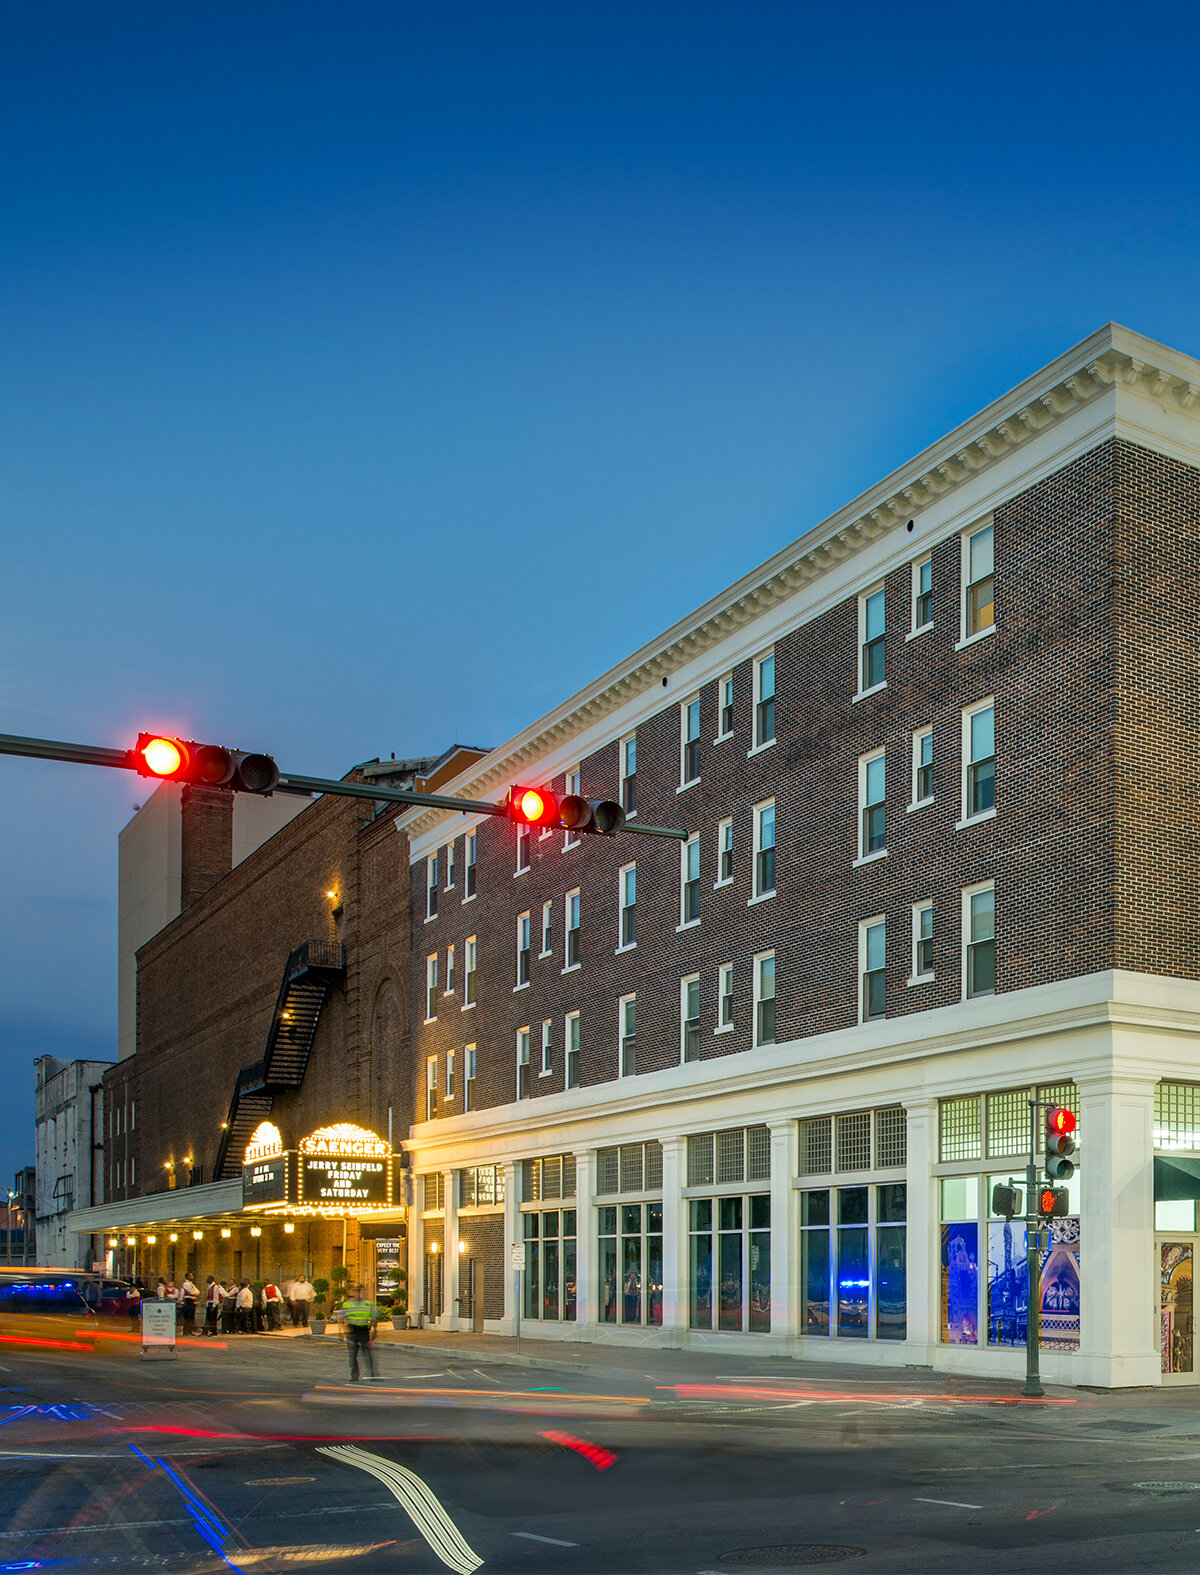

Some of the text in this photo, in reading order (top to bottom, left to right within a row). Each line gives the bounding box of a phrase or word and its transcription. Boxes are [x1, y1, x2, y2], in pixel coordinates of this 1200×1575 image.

[305, 1139, 386, 1155] SAENGER
[307, 1160, 383, 1172] JERRY SEINFELD
[327, 1170, 362, 1180] FRIDAY
[333, 1179, 352, 1189] AND
[320, 1188, 369, 1198] SATURDAY
